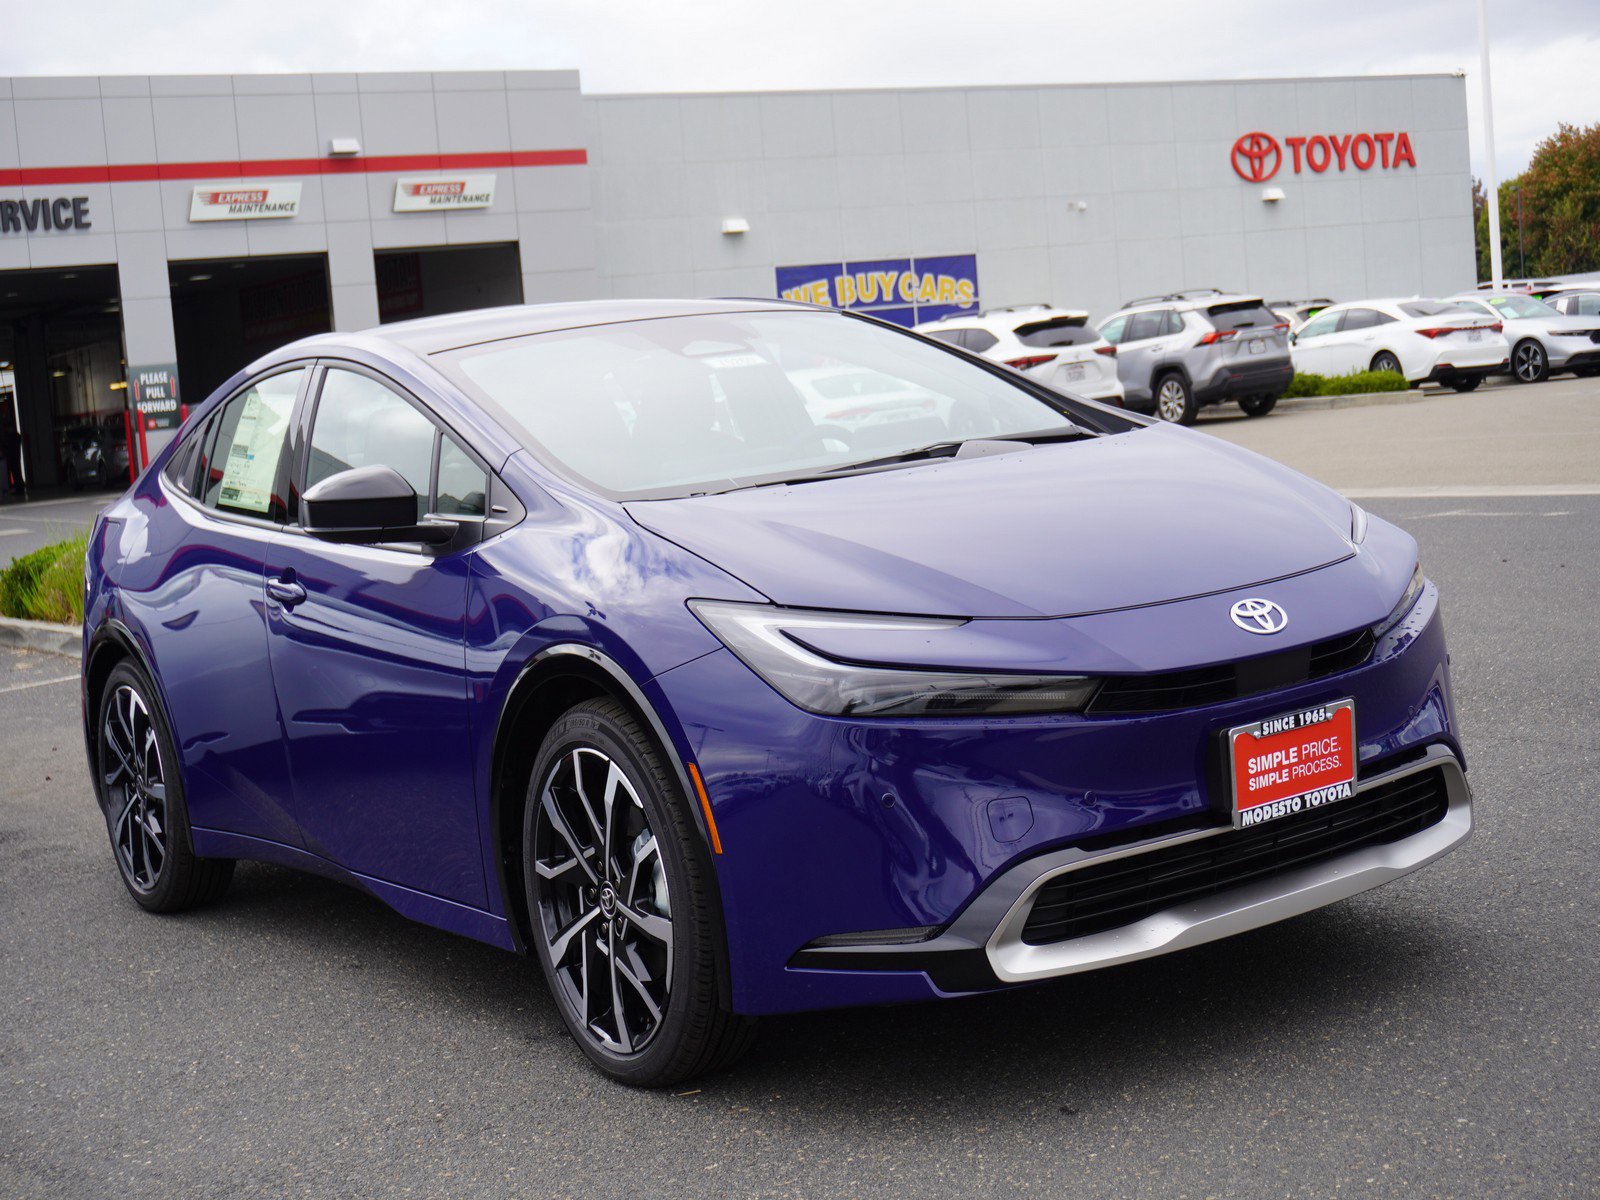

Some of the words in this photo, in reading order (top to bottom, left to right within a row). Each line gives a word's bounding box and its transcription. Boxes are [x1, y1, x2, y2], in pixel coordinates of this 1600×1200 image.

[1285, 132, 1417, 174] TOYOTA
[218, 191, 264, 203] EXPRESS
[418, 183, 461, 195] EXPRESS
[430, 193, 491, 204] MAINTENANCE
[0, 196, 92, 233] RVICE
[228, 202, 296, 214] MAINTENANCE
[834, 270, 899, 307] BUY
[898, 270, 975, 309] CARS
[140, 371, 168, 385] PLEASE
[146, 385, 166, 399] PULL
[1262, 716, 1295, 736] SINCE
[1299, 708, 1326, 726] 1965
[1247, 746, 1299, 775] SIMPLE
[1301, 736, 1341, 760] PRICE.
[1248, 768, 1290, 791] SIMPLE
[1292, 755, 1342, 779] PROCESS.
[1241, 797, 1302, 827] MODESTO
[1304, 783, 1352, 809] TOYOTA
